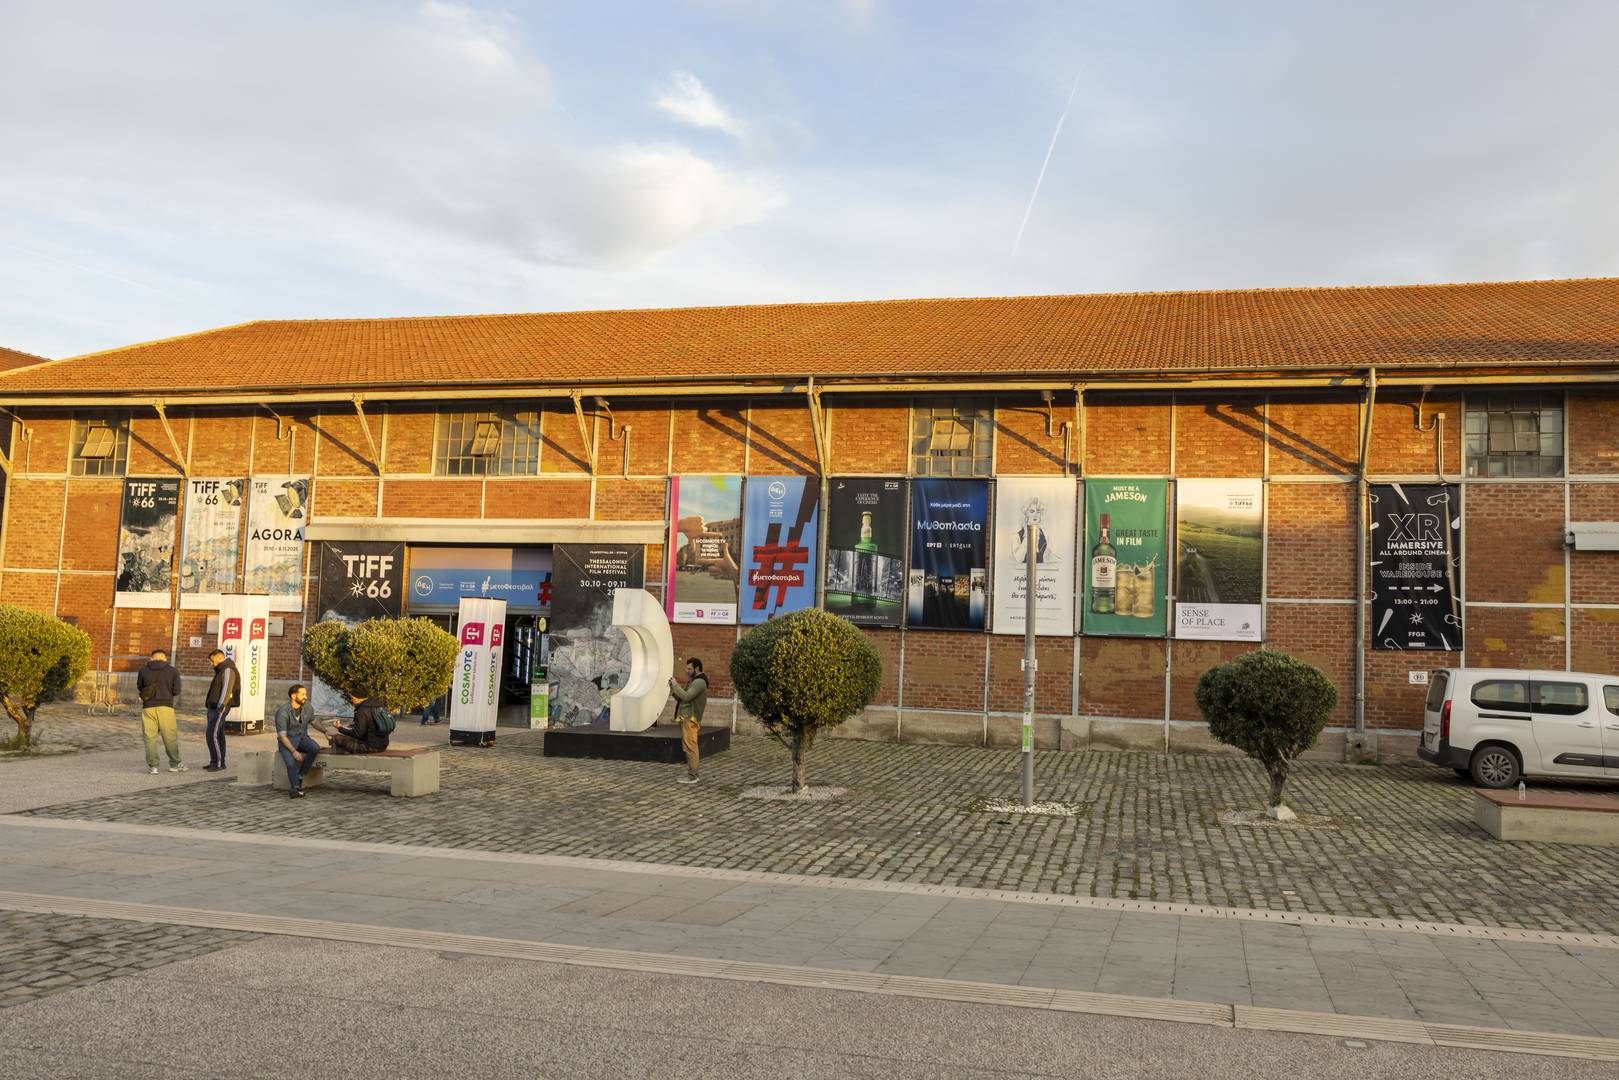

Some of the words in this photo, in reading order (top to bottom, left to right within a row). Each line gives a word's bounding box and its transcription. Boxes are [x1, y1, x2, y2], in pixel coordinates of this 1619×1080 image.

[129, 483, 156, 497] TiFF
[192, 481, 219, 494] TiFF
[141, 498, 155, 508] 66
[205, 495, 218, 505] 66
[1104, 491, 1147, 503] JAMESON
[917, 520, 981, 531] Μυθοπλασία
[1388, 513, 1443, 541] XR
[251, 528, 303, 541] AGORA
[1116, 529, 1137, 537] GREAT
[342, 554, 394, 578] TiFF
[1380, 570, 1442, 578] WAREHOUSE
[367, 580, 391, 598] 66
[1181, 609, 1209, 617] SENSE
[1197, 618, 1225, 626] PLACE
[250, 645, 258, 696] COSMOTE
[461, 650, 472, 705] COSMOTE
[488, 652, 496, 706] COSMOTE
